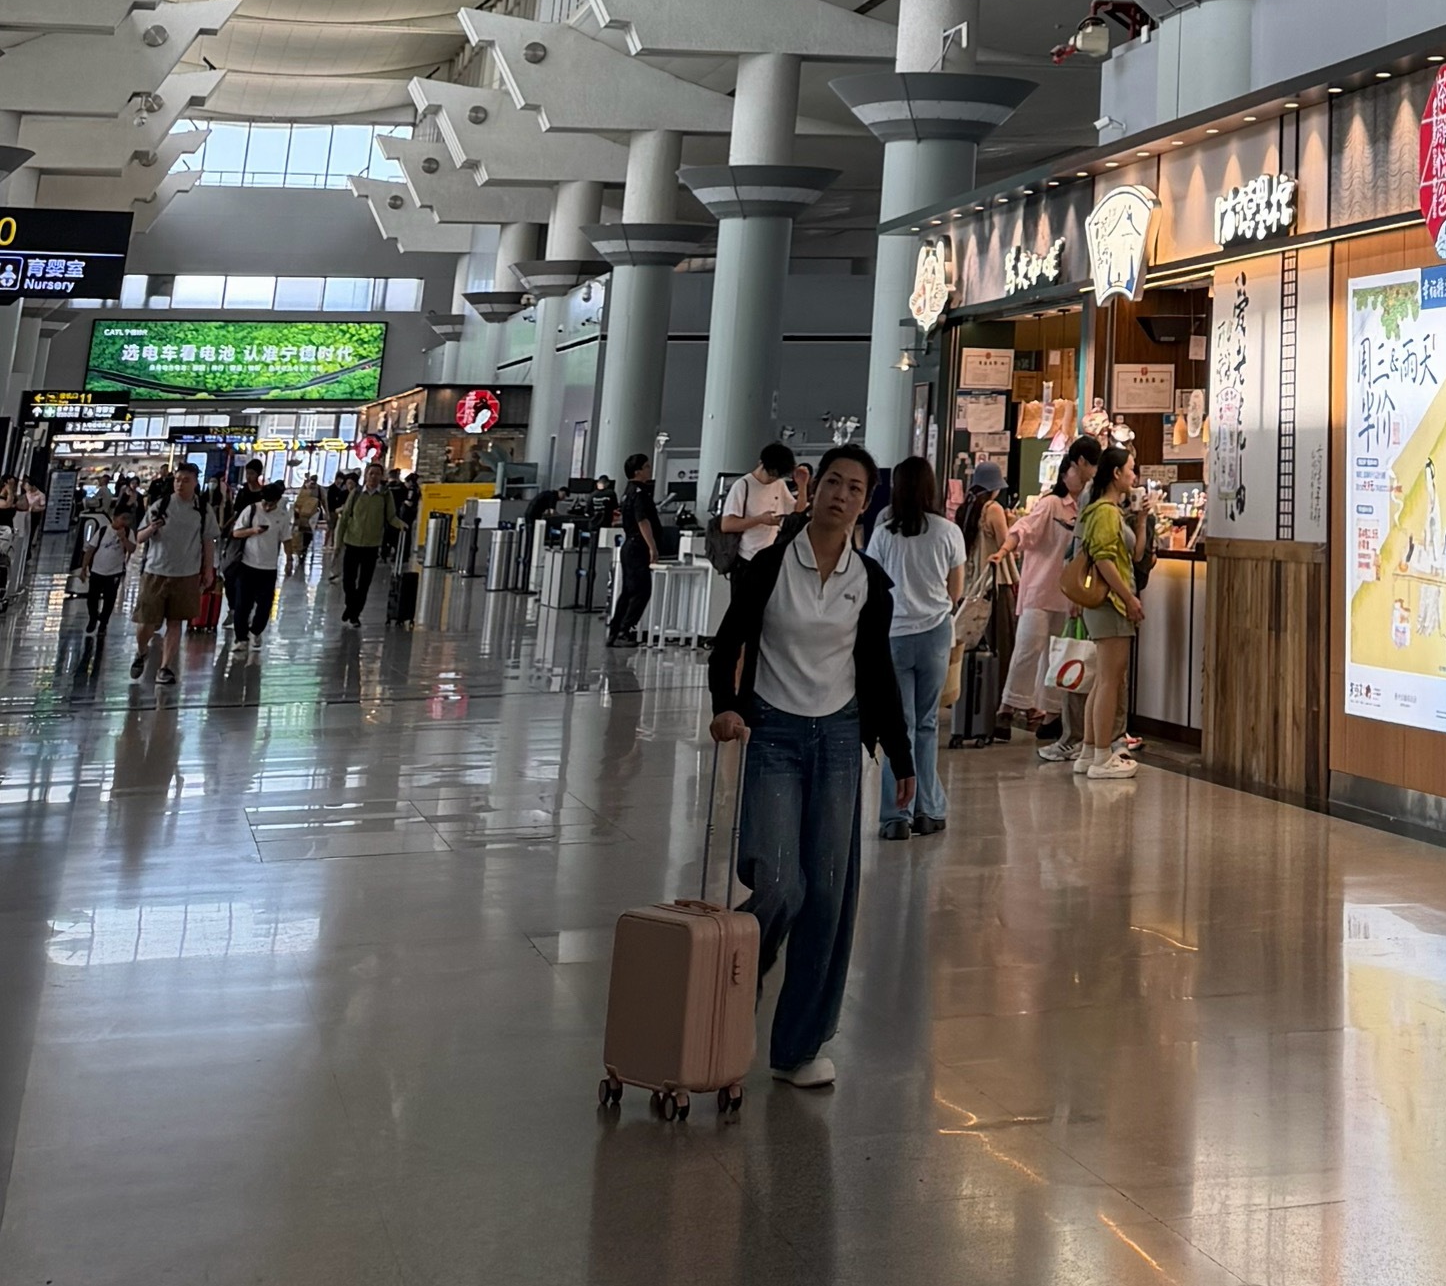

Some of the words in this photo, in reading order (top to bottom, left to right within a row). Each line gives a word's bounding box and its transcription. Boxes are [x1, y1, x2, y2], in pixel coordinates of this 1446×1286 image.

[27, 258, 86, 278] 育婴室
[24, 279, 75, 293] Nursery
[122, 344, 236, 362] 选电车看电池
[243, 344, 353, 362] 认准宁德时代
[1358, 390, 1396, 453] 半价
